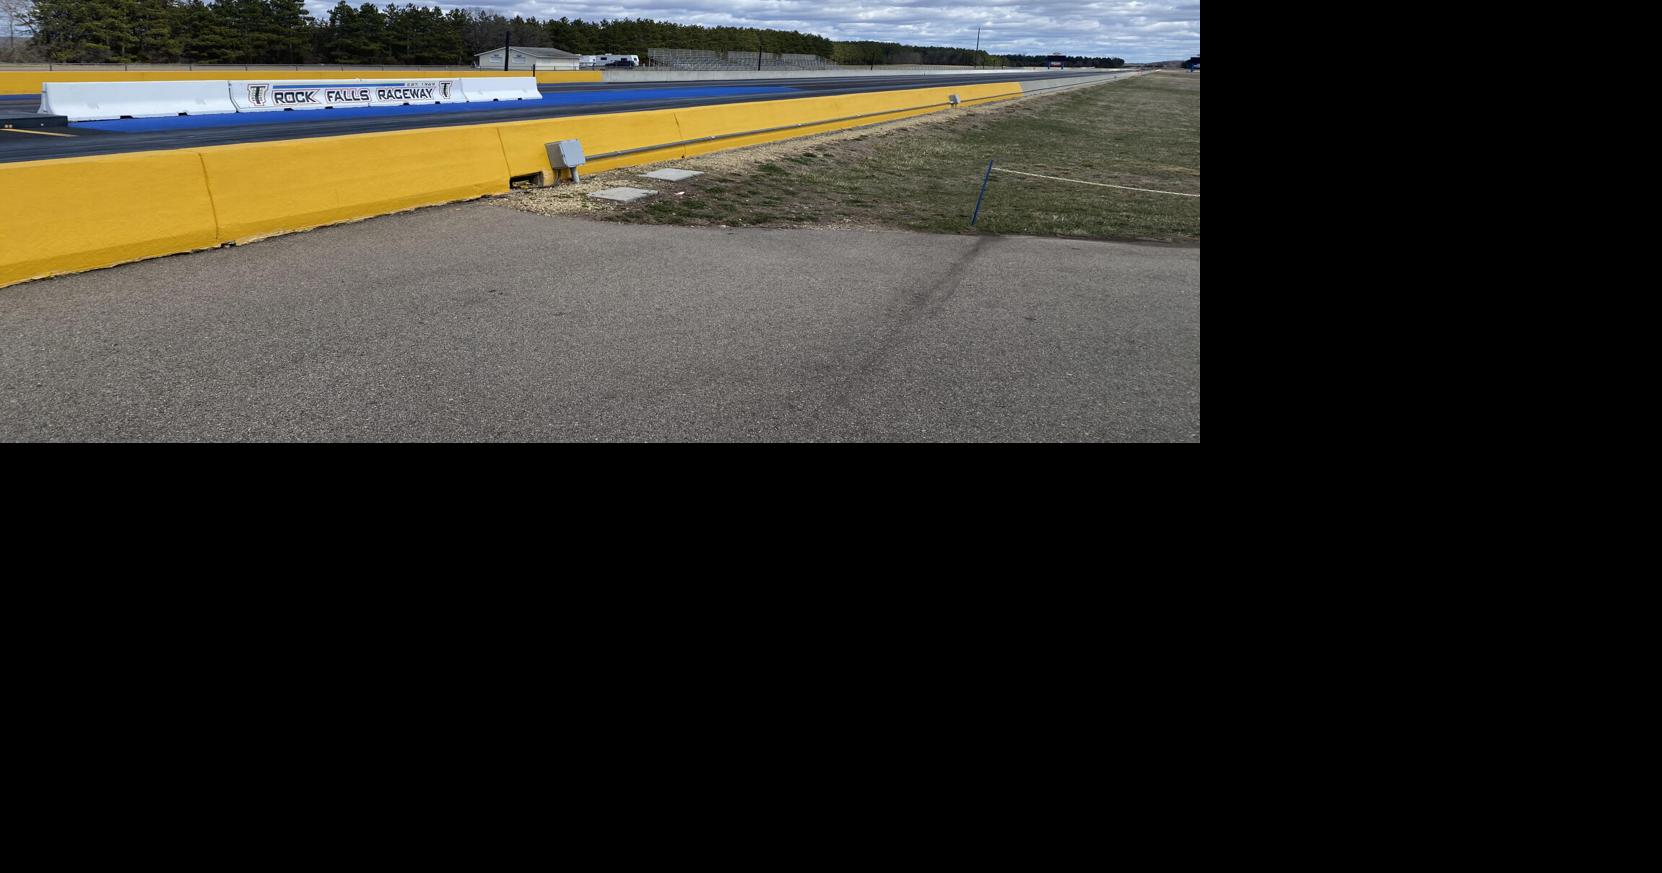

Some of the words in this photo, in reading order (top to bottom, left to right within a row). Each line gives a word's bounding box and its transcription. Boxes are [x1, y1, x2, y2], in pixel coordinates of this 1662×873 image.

[274, 91, 317, 104] ROCK
[327, 89, 369, 102] FALLS
[378, 88, 432, 100] RACEWAY
